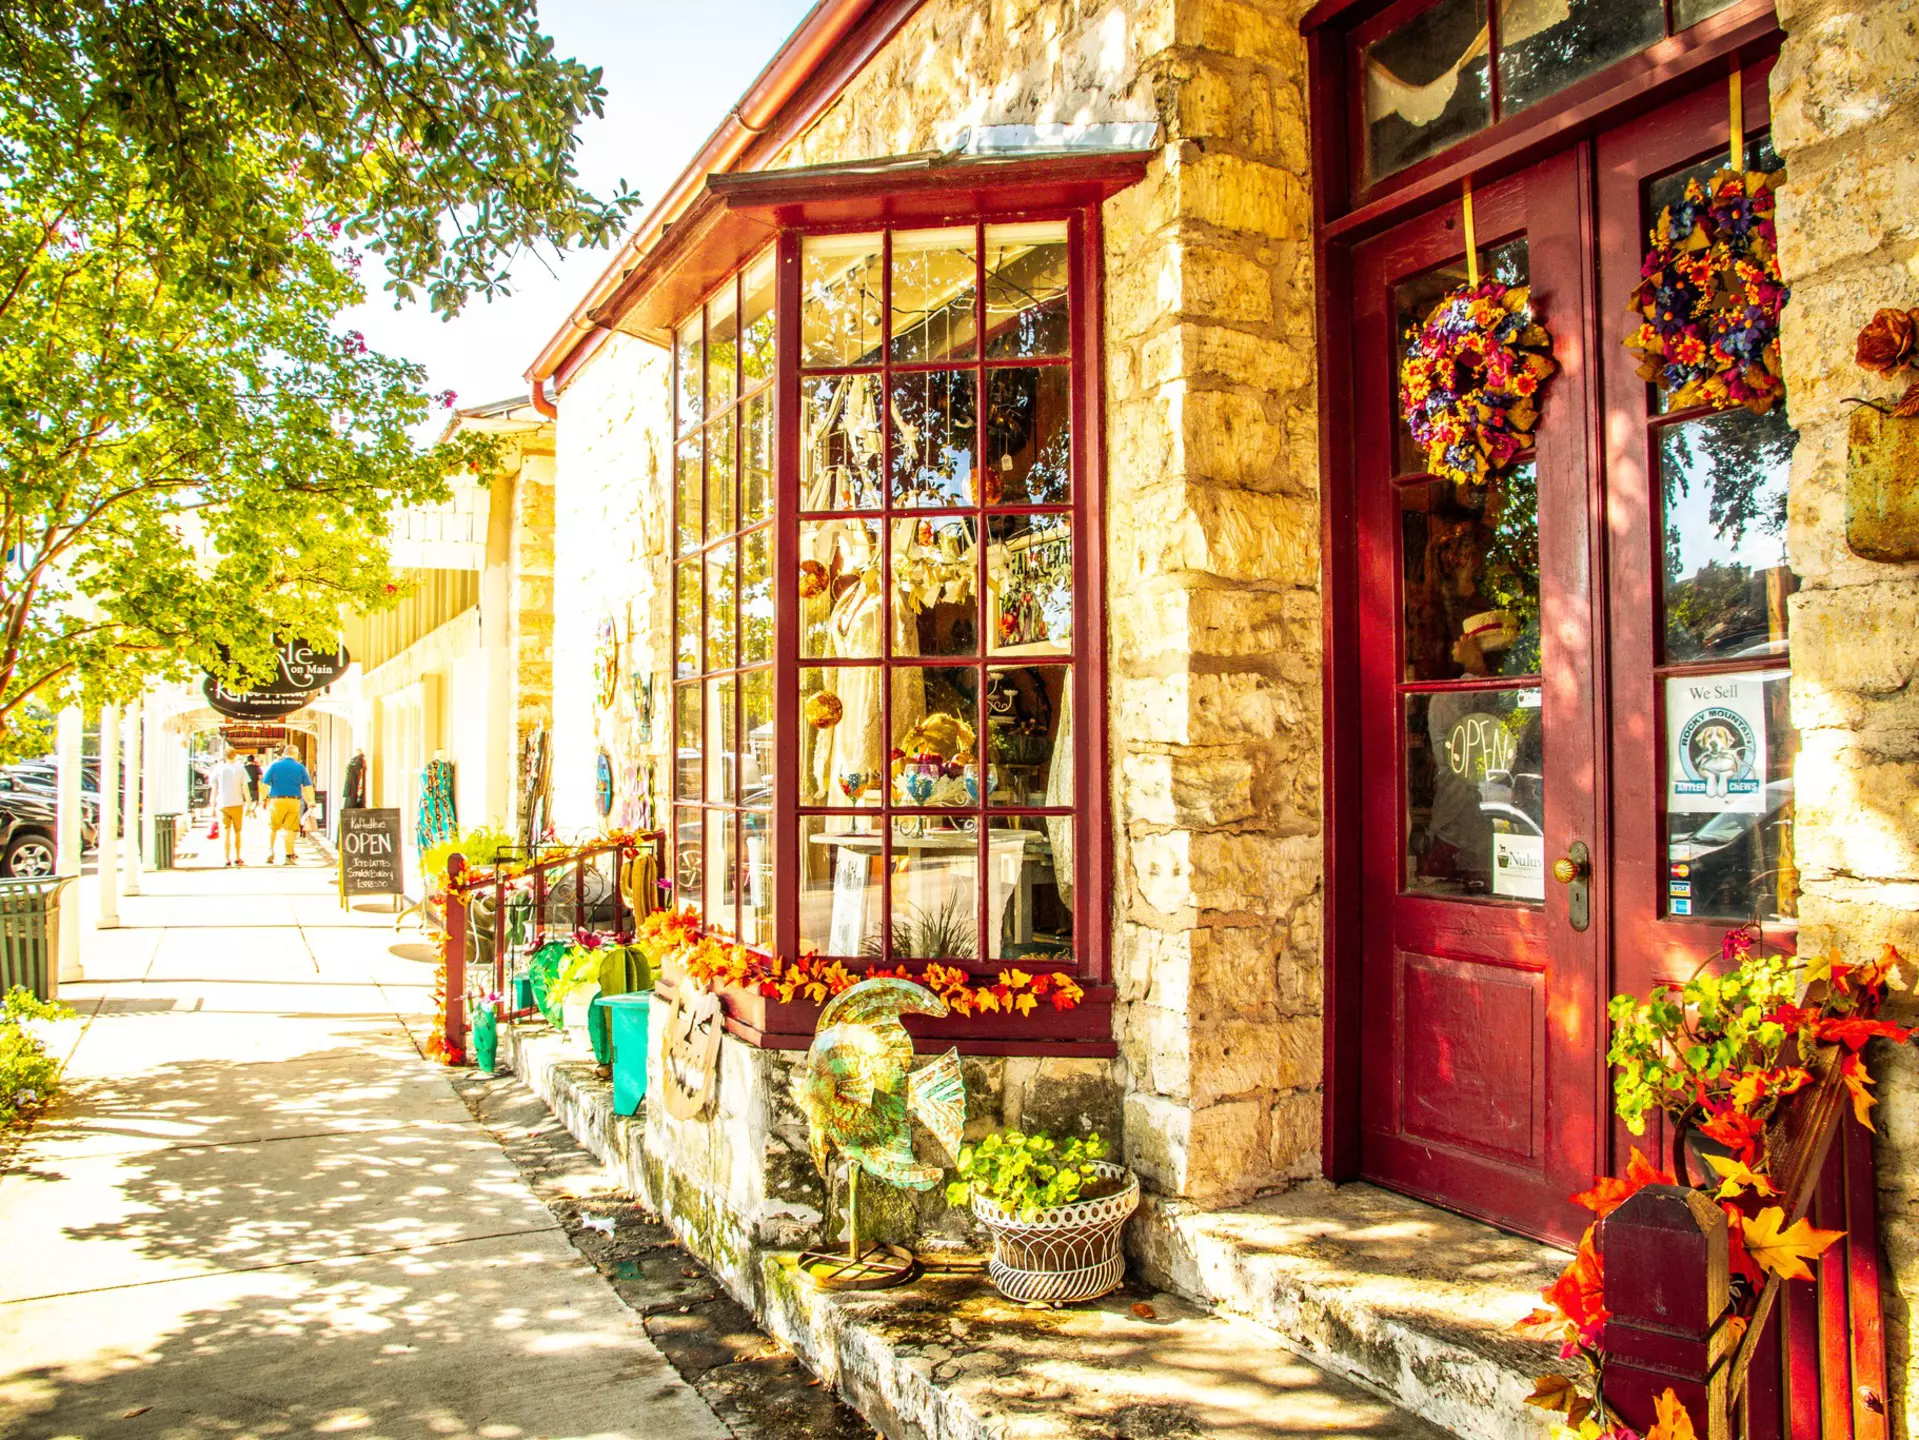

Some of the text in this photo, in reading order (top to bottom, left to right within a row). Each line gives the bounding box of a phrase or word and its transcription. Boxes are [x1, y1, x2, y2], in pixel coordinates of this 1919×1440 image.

[291, 664, 333, 674] on Main
[1690, 684, 1738, 700] We Sell
[1682, 710, 1752, 746] ROCKY MOUNTAIN
[1451, 719, 1508, 781] OPEN
[1676, 783, 1706, 791] ANTLER
[345, 833, 392, 854] OPEN
